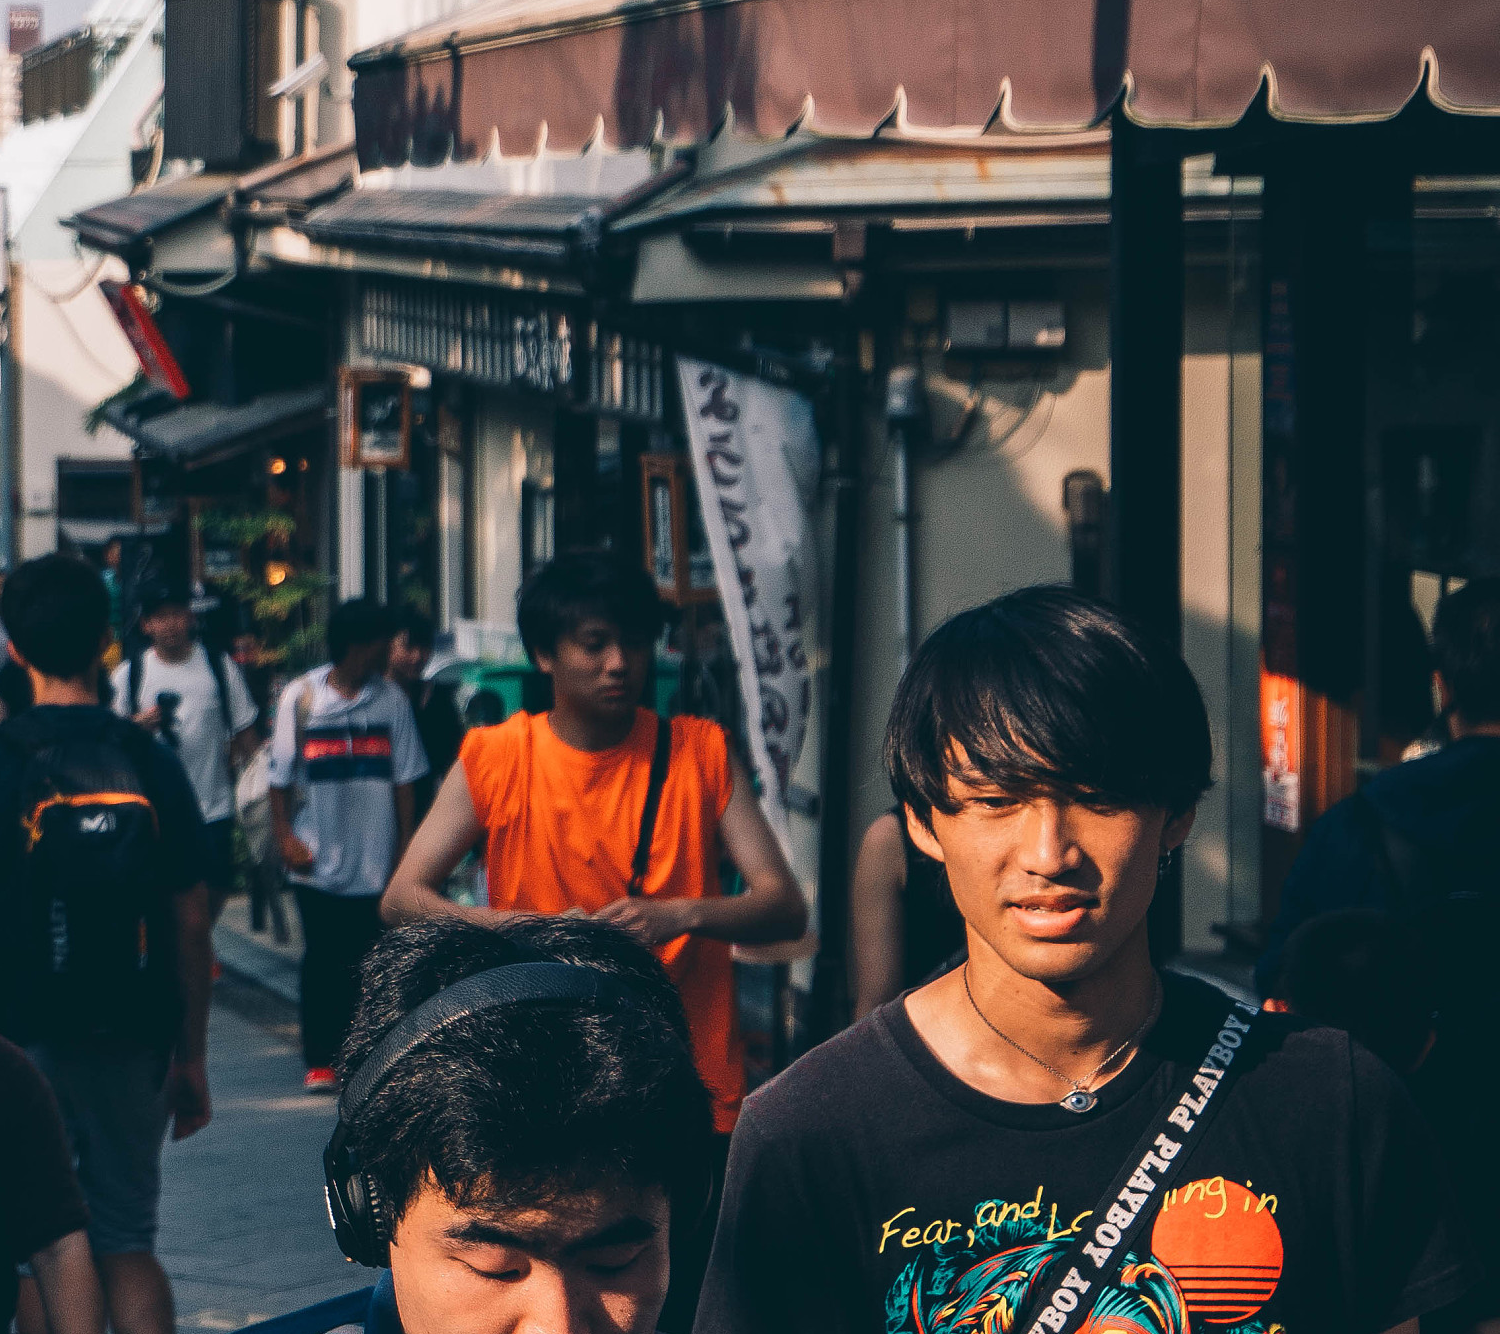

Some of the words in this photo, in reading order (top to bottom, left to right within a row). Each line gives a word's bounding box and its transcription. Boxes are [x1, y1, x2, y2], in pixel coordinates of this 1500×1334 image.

[1167, 1013, 1251, 1133] PLAYBOY
[975, 1185, 1044, 1229] and
[1243, 1180, 1280, 1216] in
[1081, 1132, 1183, 1269] PLAYBOY
